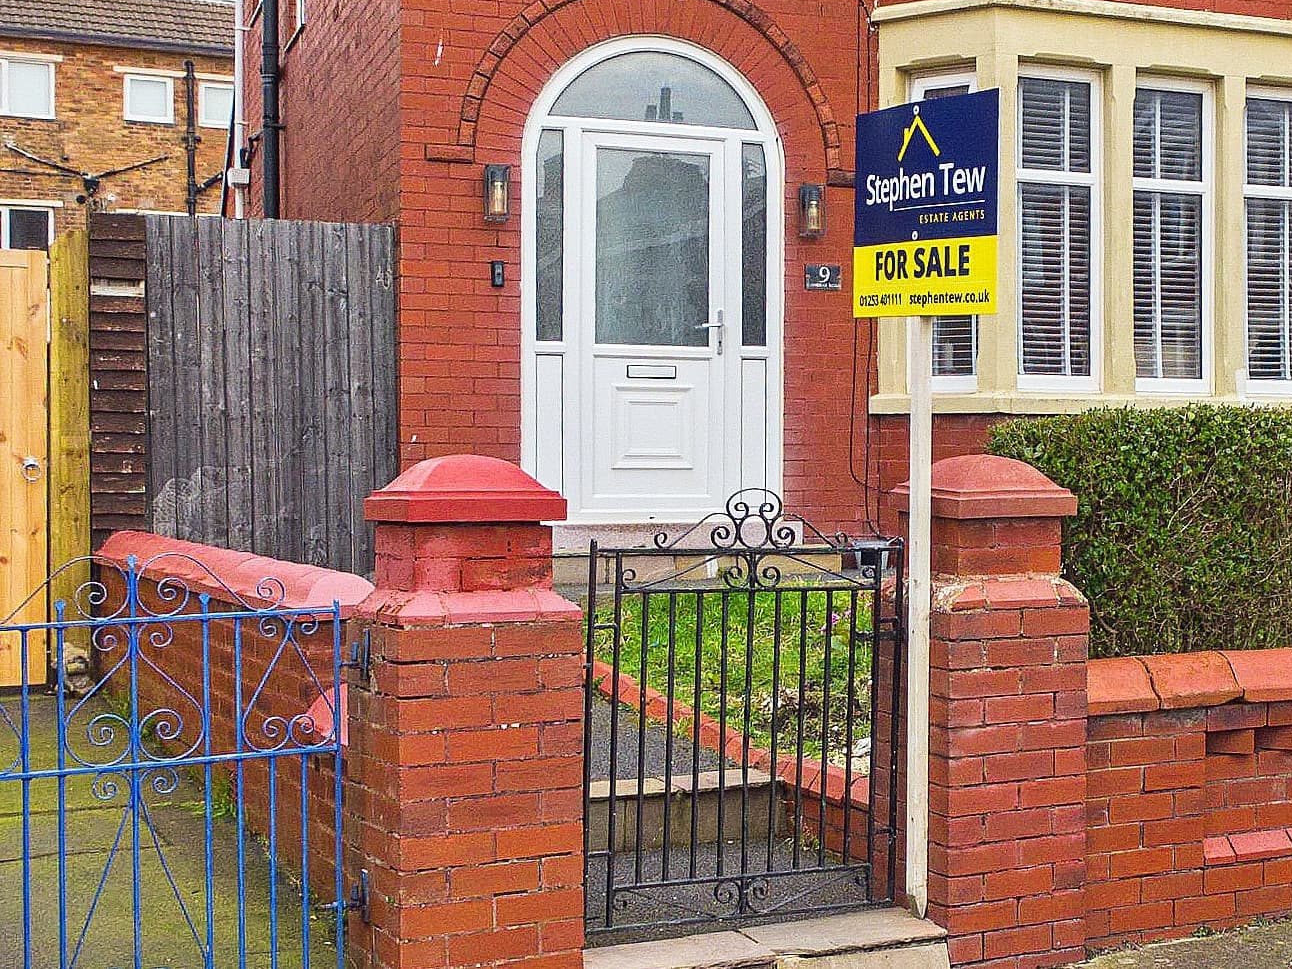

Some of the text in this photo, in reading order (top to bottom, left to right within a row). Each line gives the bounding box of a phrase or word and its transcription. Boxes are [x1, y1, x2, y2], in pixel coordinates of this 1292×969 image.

[866, 162, 986, 212] Stephen Tew
[919, 209, 985, 224] ESTATE AGENTS
[875, 244, 970, 281] FOR SALE
[819, 266, 831, 283] 9
[909, 288, 990, 308] stephentew.co.uk
